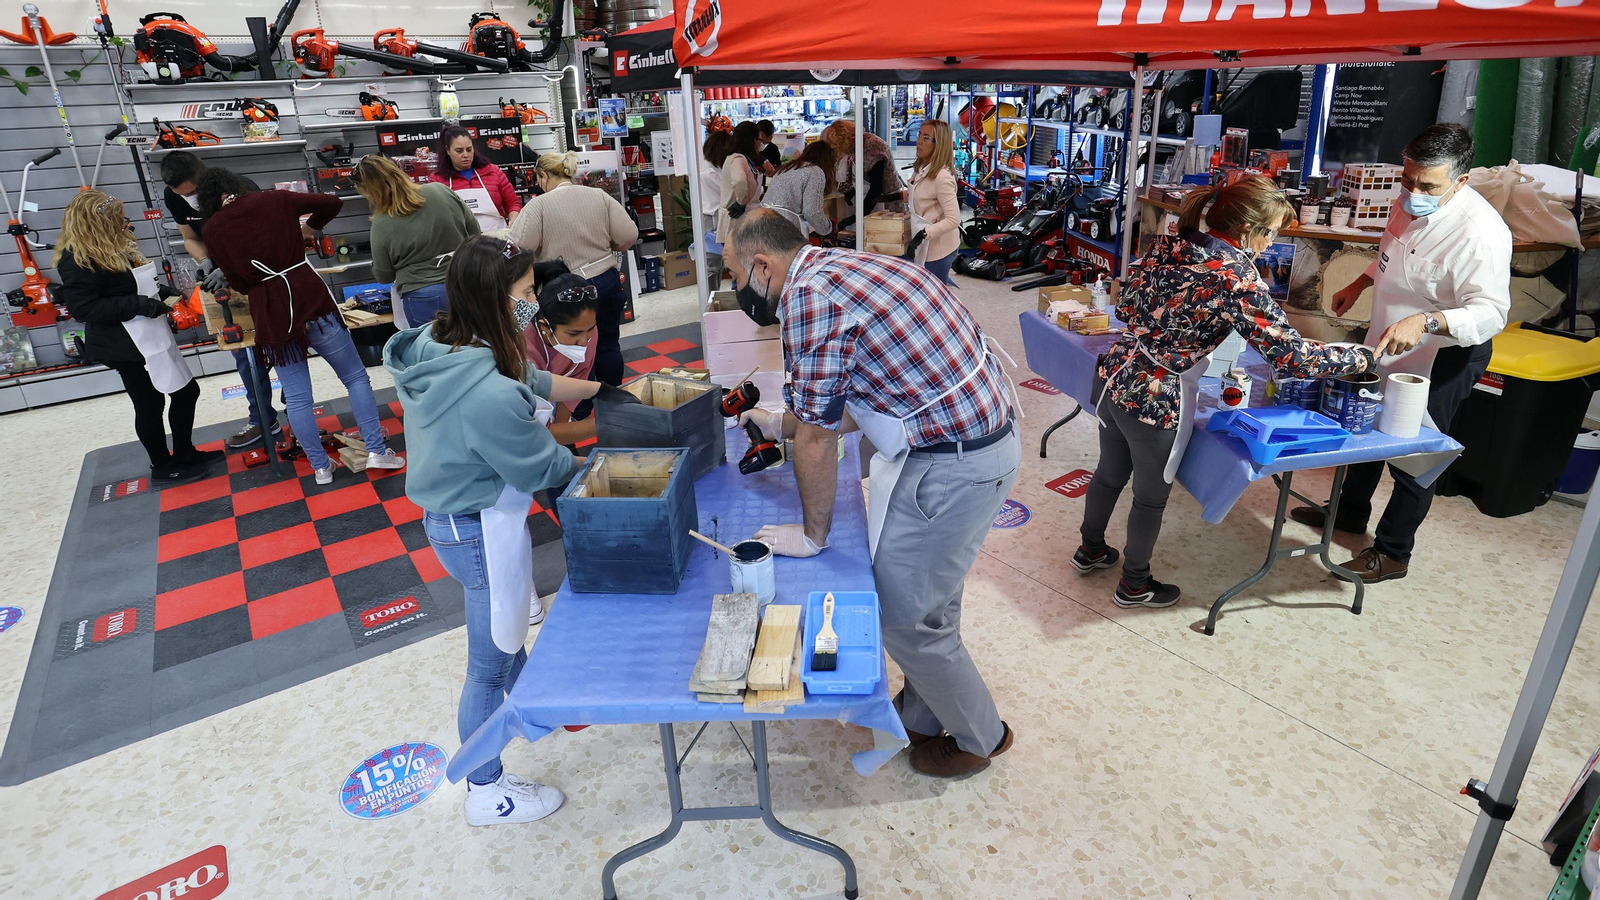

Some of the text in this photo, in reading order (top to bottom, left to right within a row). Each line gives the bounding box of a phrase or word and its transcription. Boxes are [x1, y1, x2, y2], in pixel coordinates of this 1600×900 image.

[684, 1, 720, 42] TITANLUX
[628, 48, 675, 70] Einhell
[1335, 84, 1358, 92] Santiago
[479, 126, 519, 136] Einhell
[1077, 245, 1111, 272] HONDA
[364, 621, 399, 637] Count
[356, 745, 427, 794] 15%
[358, 765, 437, 806] BONIFICACIÓN
[370, 776, 432, 810] EN PUNTOS
